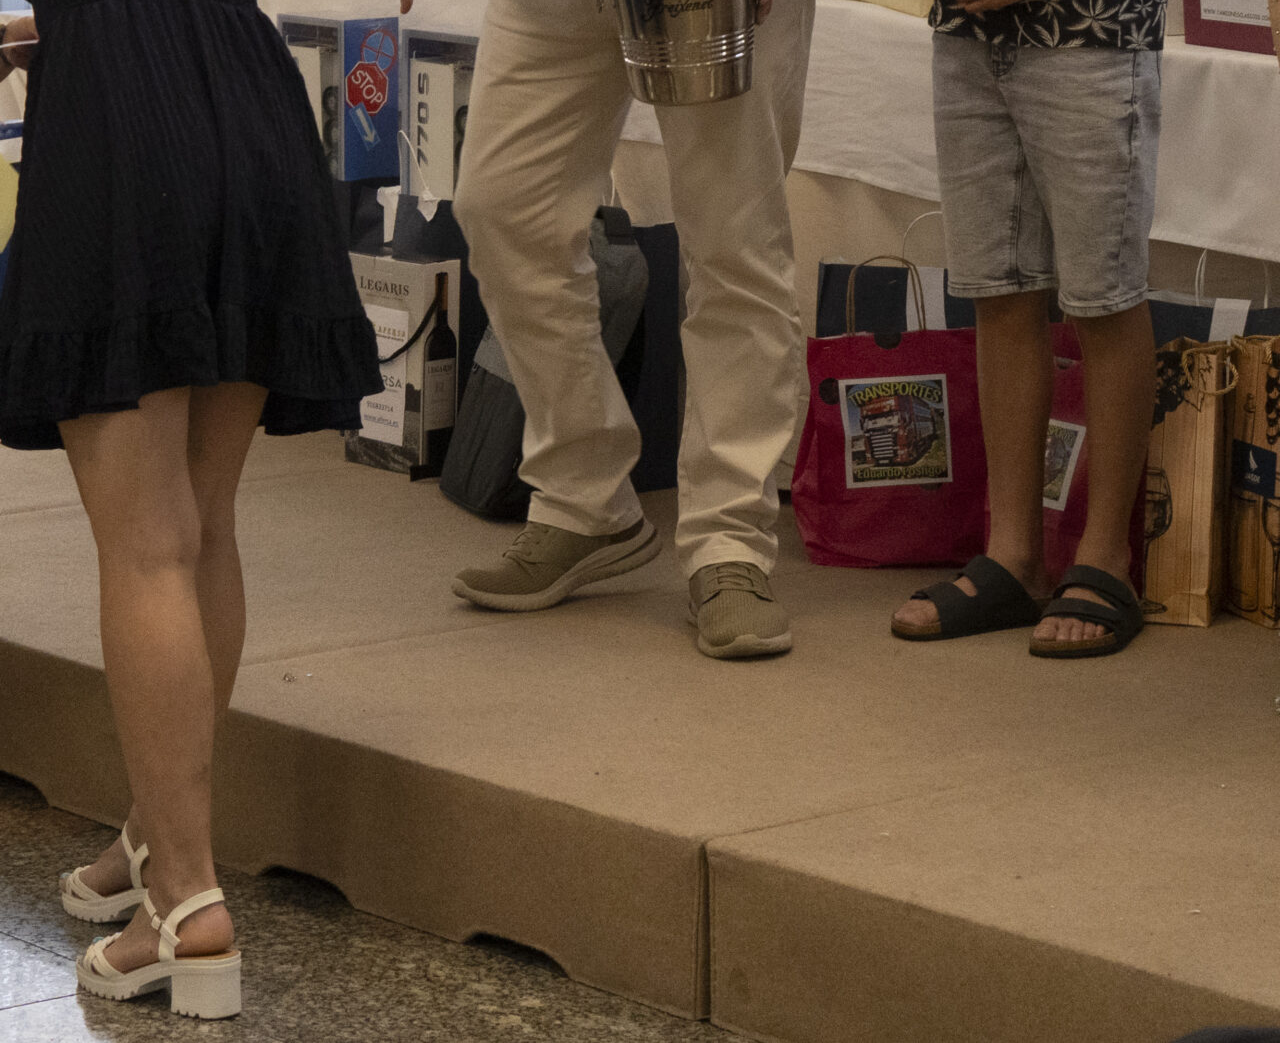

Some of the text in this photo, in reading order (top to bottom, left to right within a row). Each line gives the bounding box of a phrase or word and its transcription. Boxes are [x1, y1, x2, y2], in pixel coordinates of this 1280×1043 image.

[351, 69, 383, 105] STOP
[360, 275, 410, 297] LEGARIS
[383, 374, 402, 388] RSA
[848, 382, 942, 406] TRANSPORTES
